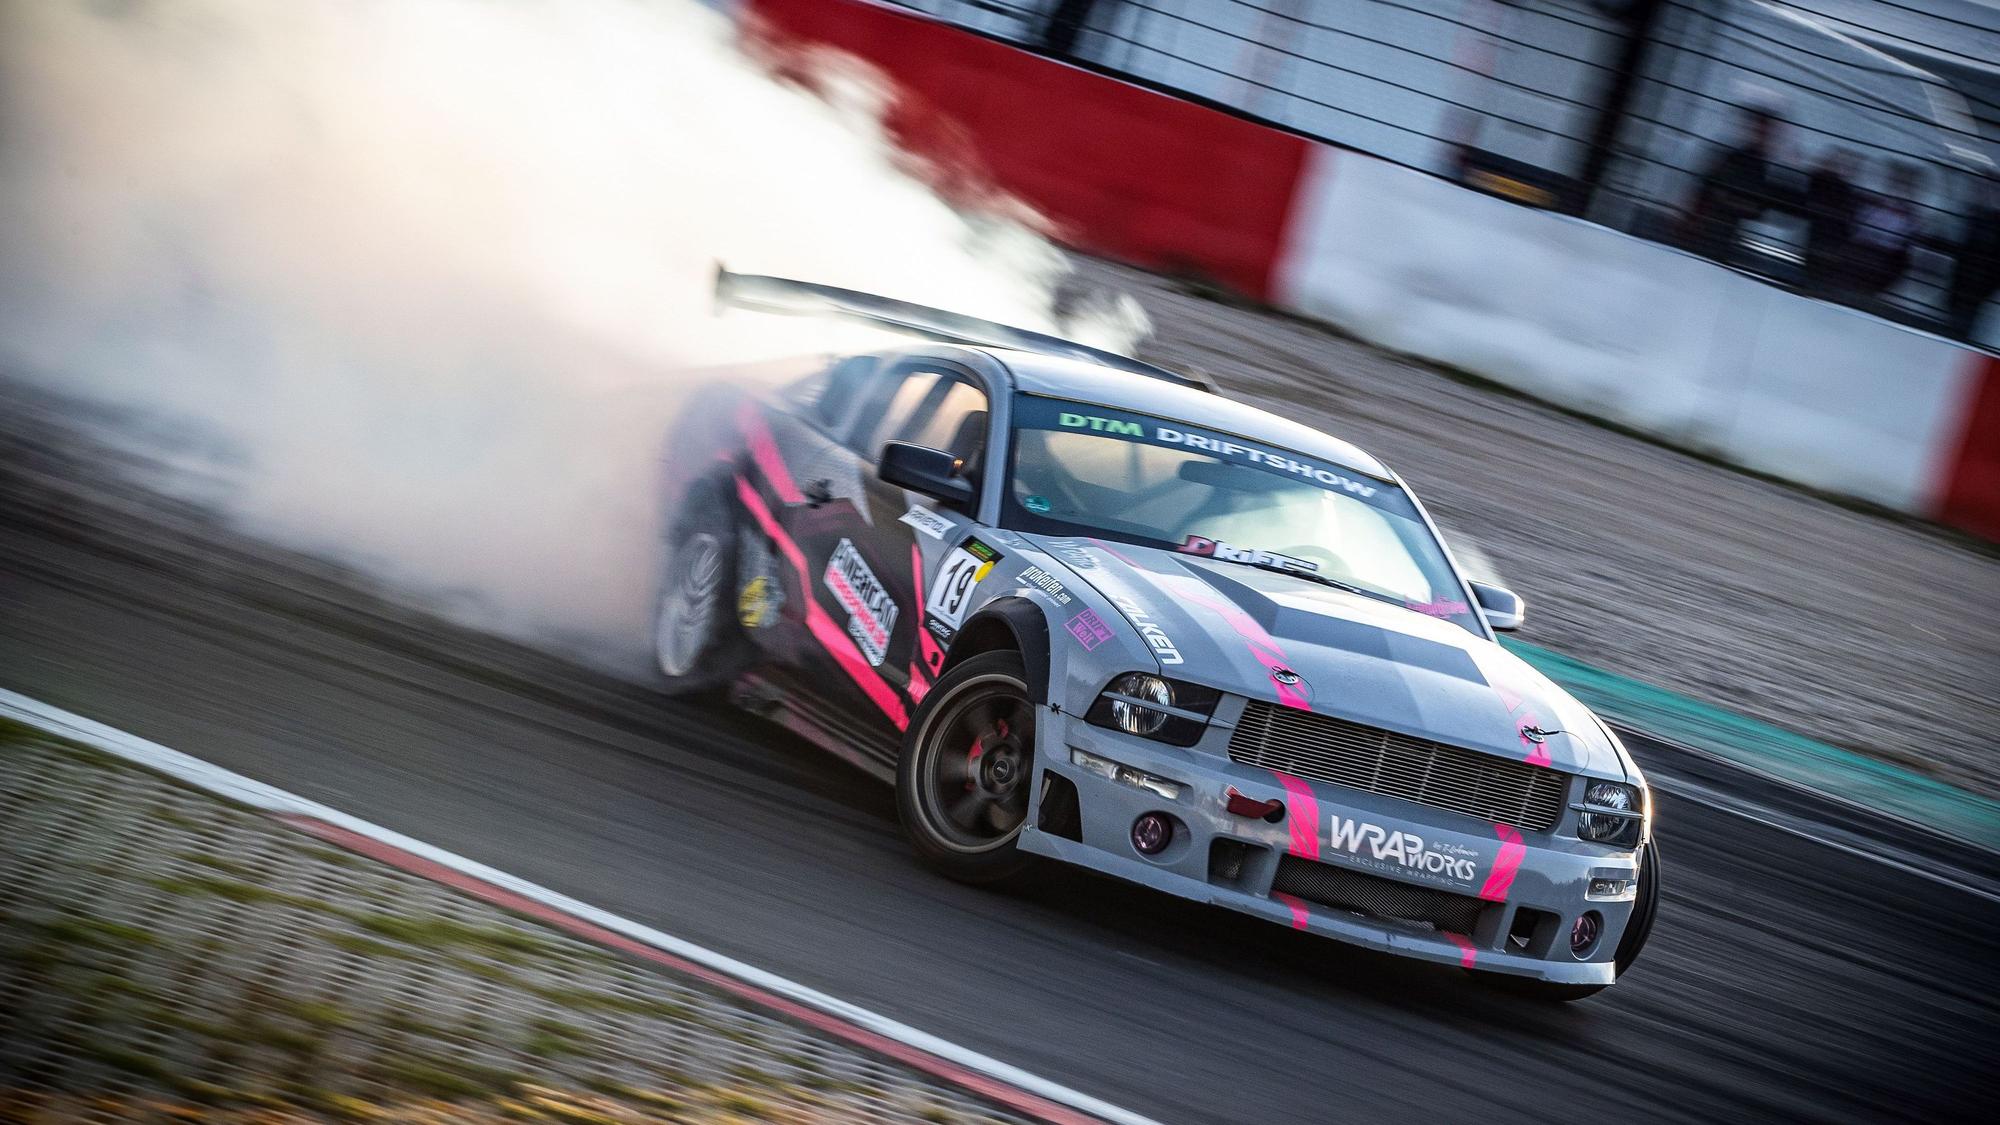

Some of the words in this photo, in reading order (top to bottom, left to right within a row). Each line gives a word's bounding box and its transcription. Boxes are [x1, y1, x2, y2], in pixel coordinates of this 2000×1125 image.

[1059, 412, 1145, 437] DTM
[1156, 427, 1377, 498] DRIFTSHOW
[939, 558, 976, 614] 19
[1079, 610, 1114, 639] DRIFT
[1350, 856, 1401, 874] EXCLUSIVE
[1406, 870, 1454, 886] WRAPPING
